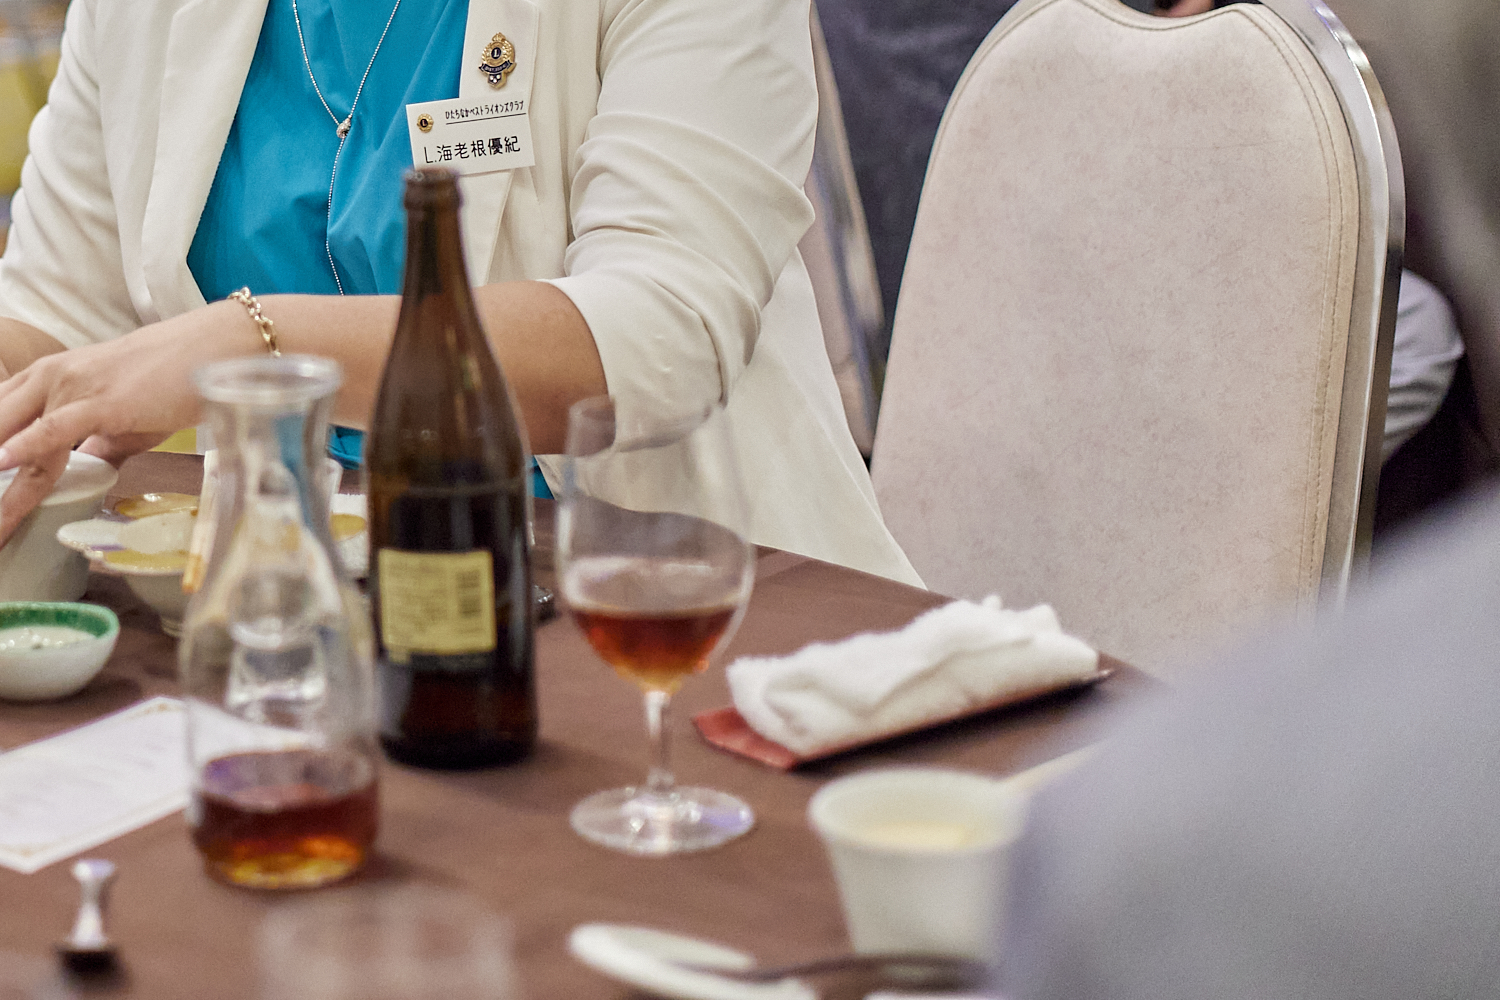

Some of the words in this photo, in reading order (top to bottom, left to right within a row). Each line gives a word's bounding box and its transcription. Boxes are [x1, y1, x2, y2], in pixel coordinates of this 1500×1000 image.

[423, 136, 521, 164] L.海老根優紀
